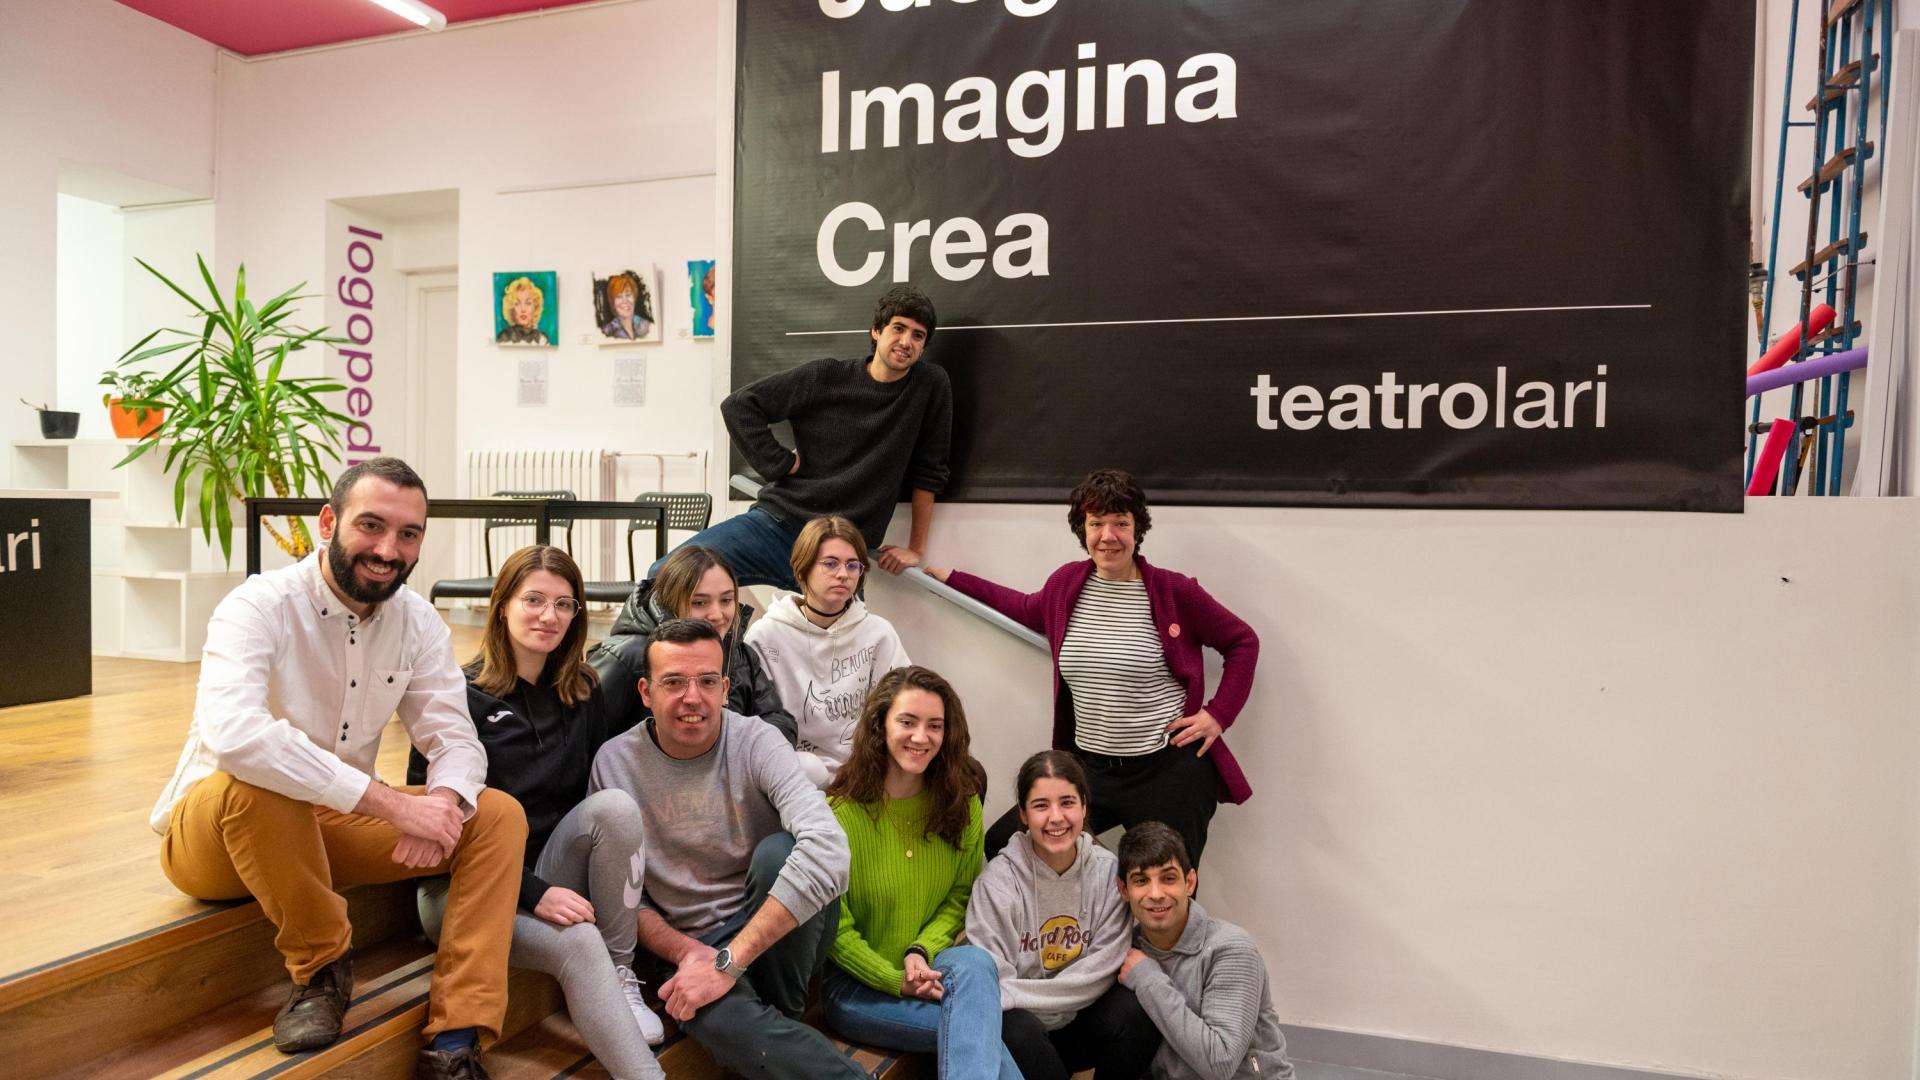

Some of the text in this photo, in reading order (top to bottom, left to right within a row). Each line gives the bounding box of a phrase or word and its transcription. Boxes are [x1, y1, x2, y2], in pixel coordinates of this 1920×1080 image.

[821, 42, 1238, 158] Imagina
[816, 202, 1050, 287] Crea
[1250, 364, 1608, 431] teatrolari
[0, 518, 41, 573] ri
[831, 642, 878, 684] BEAUTIF
[1019, 925, 1092, 953] Hard Roc
